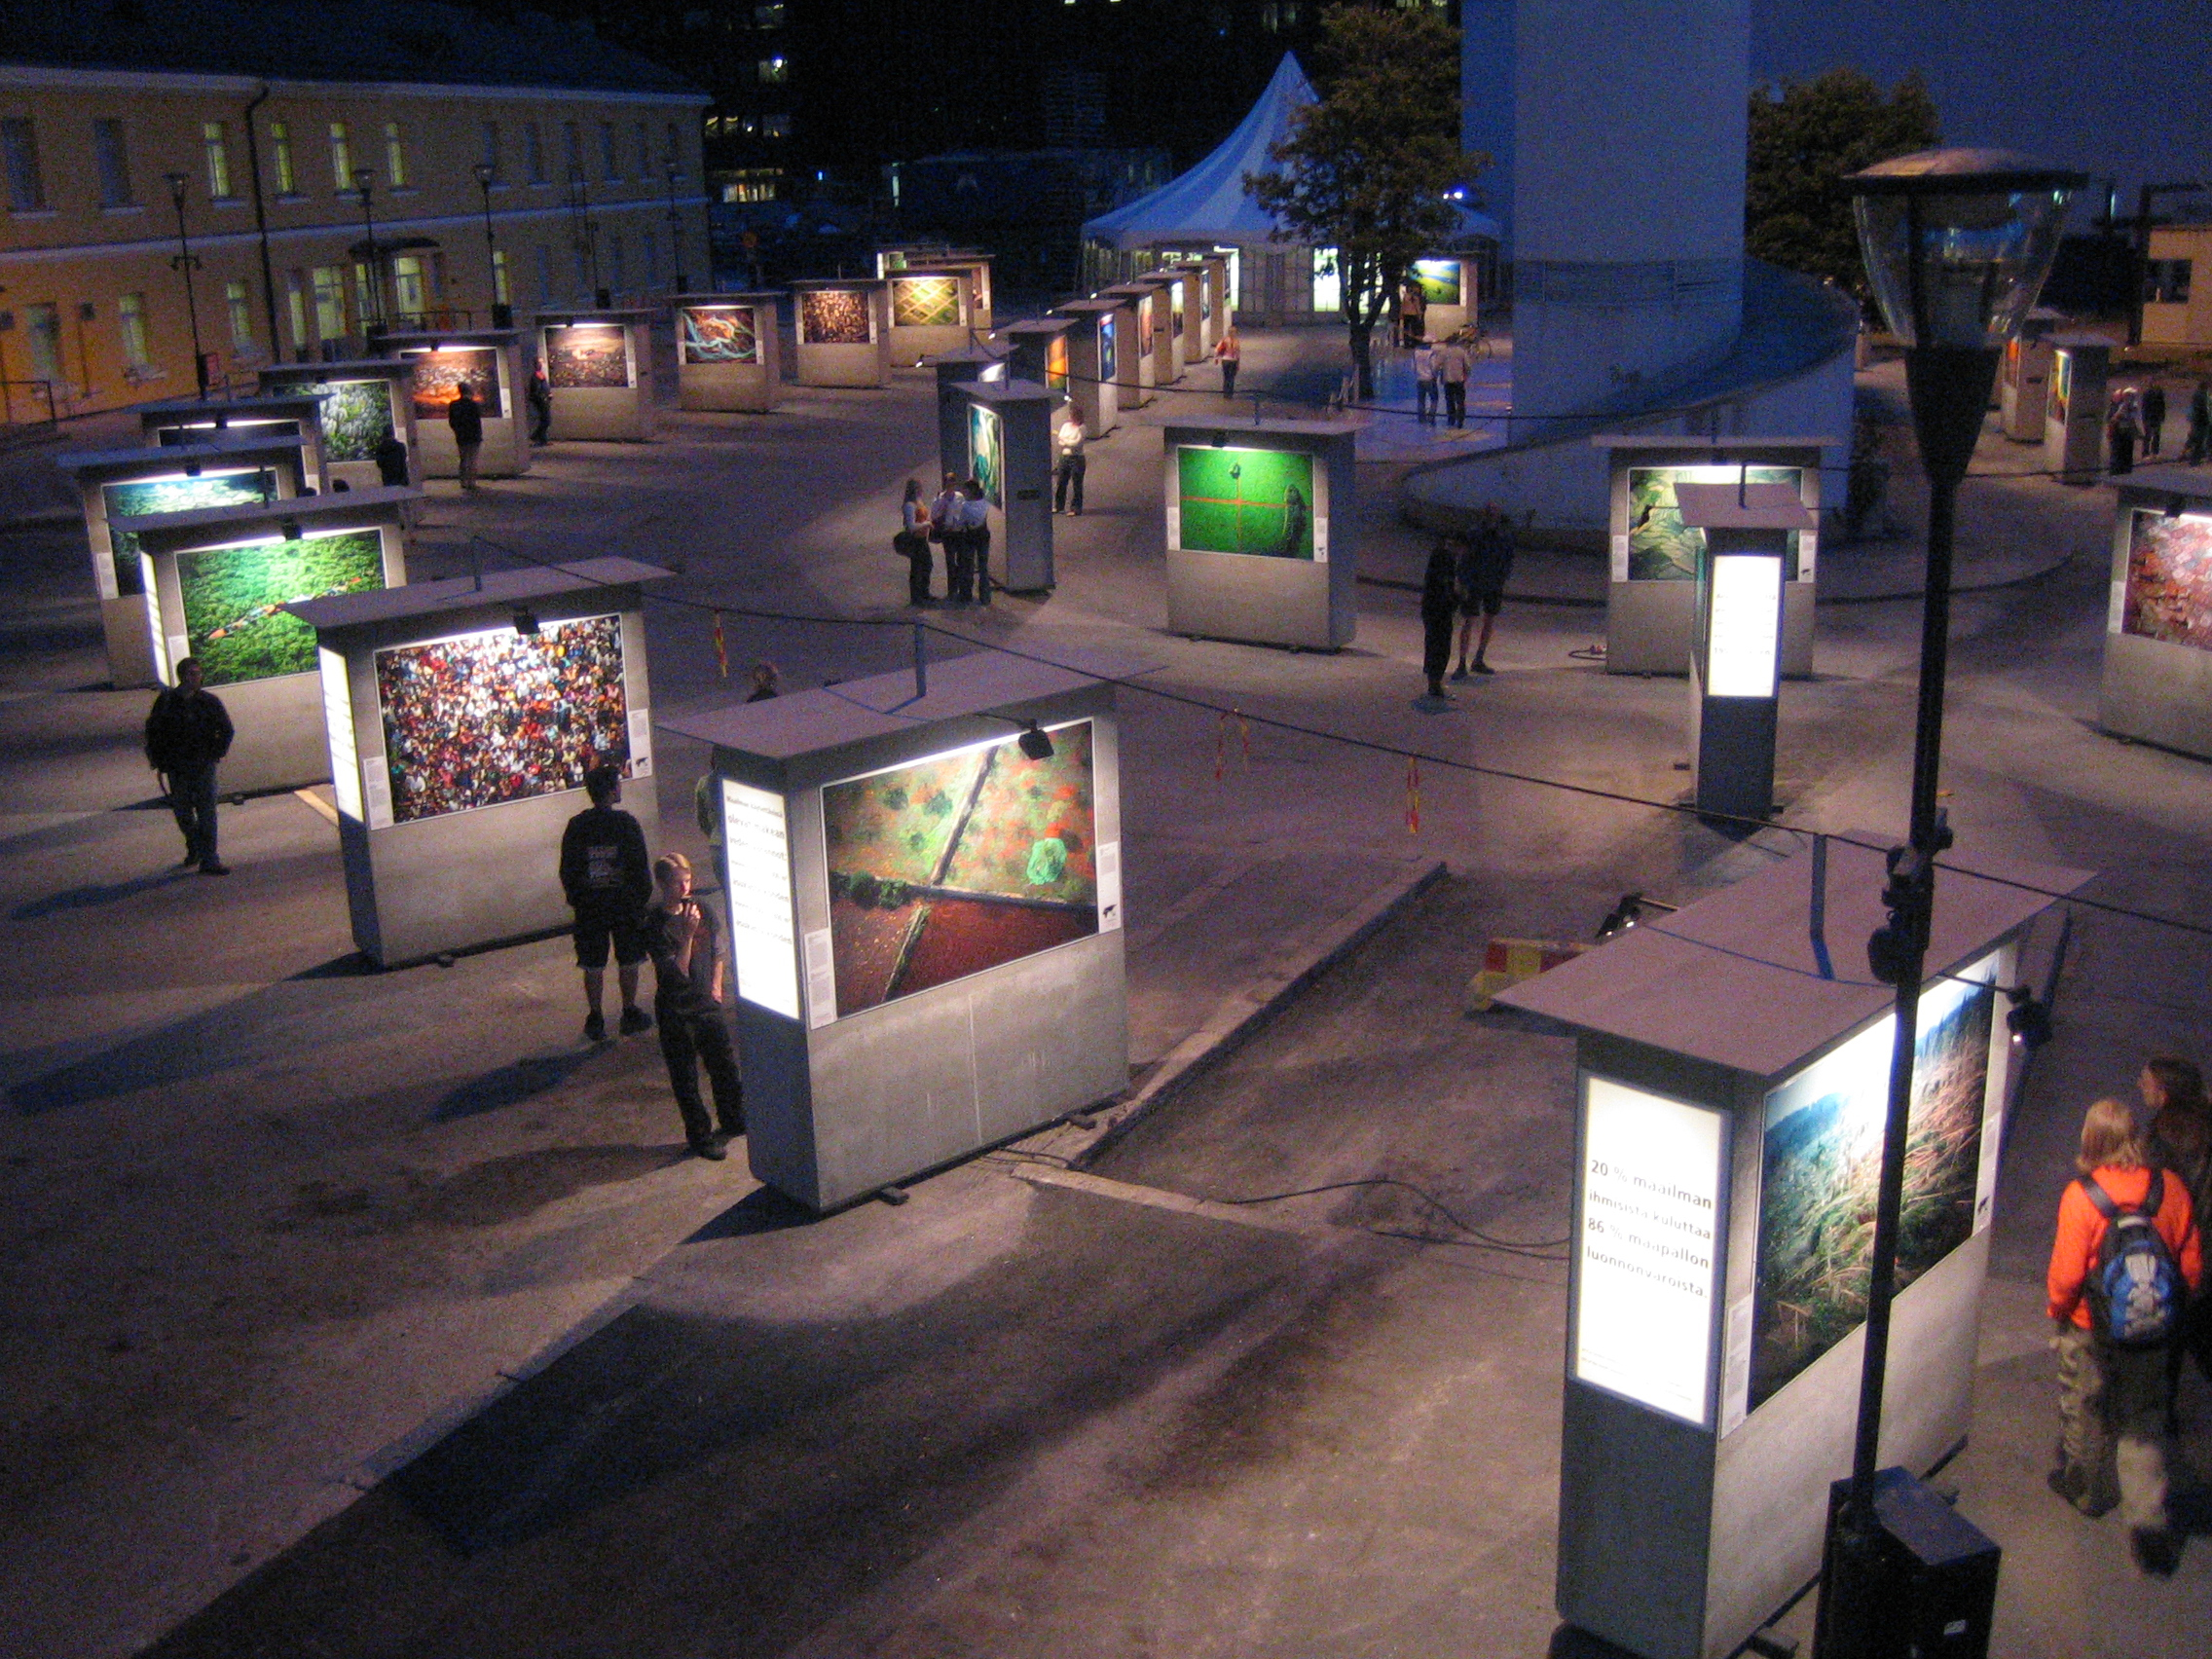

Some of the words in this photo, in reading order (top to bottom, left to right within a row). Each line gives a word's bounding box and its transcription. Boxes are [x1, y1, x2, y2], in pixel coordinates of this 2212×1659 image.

[1591, 1160, 1608, 1176] 20
[1634, 1176, 1713, 1209] maailman
[1588, 1217, 1605, 1234] 86
[1628, 1234, 1711, 1270] maapallon
[1653, 1211, 1712, 1240] kuluttaa
